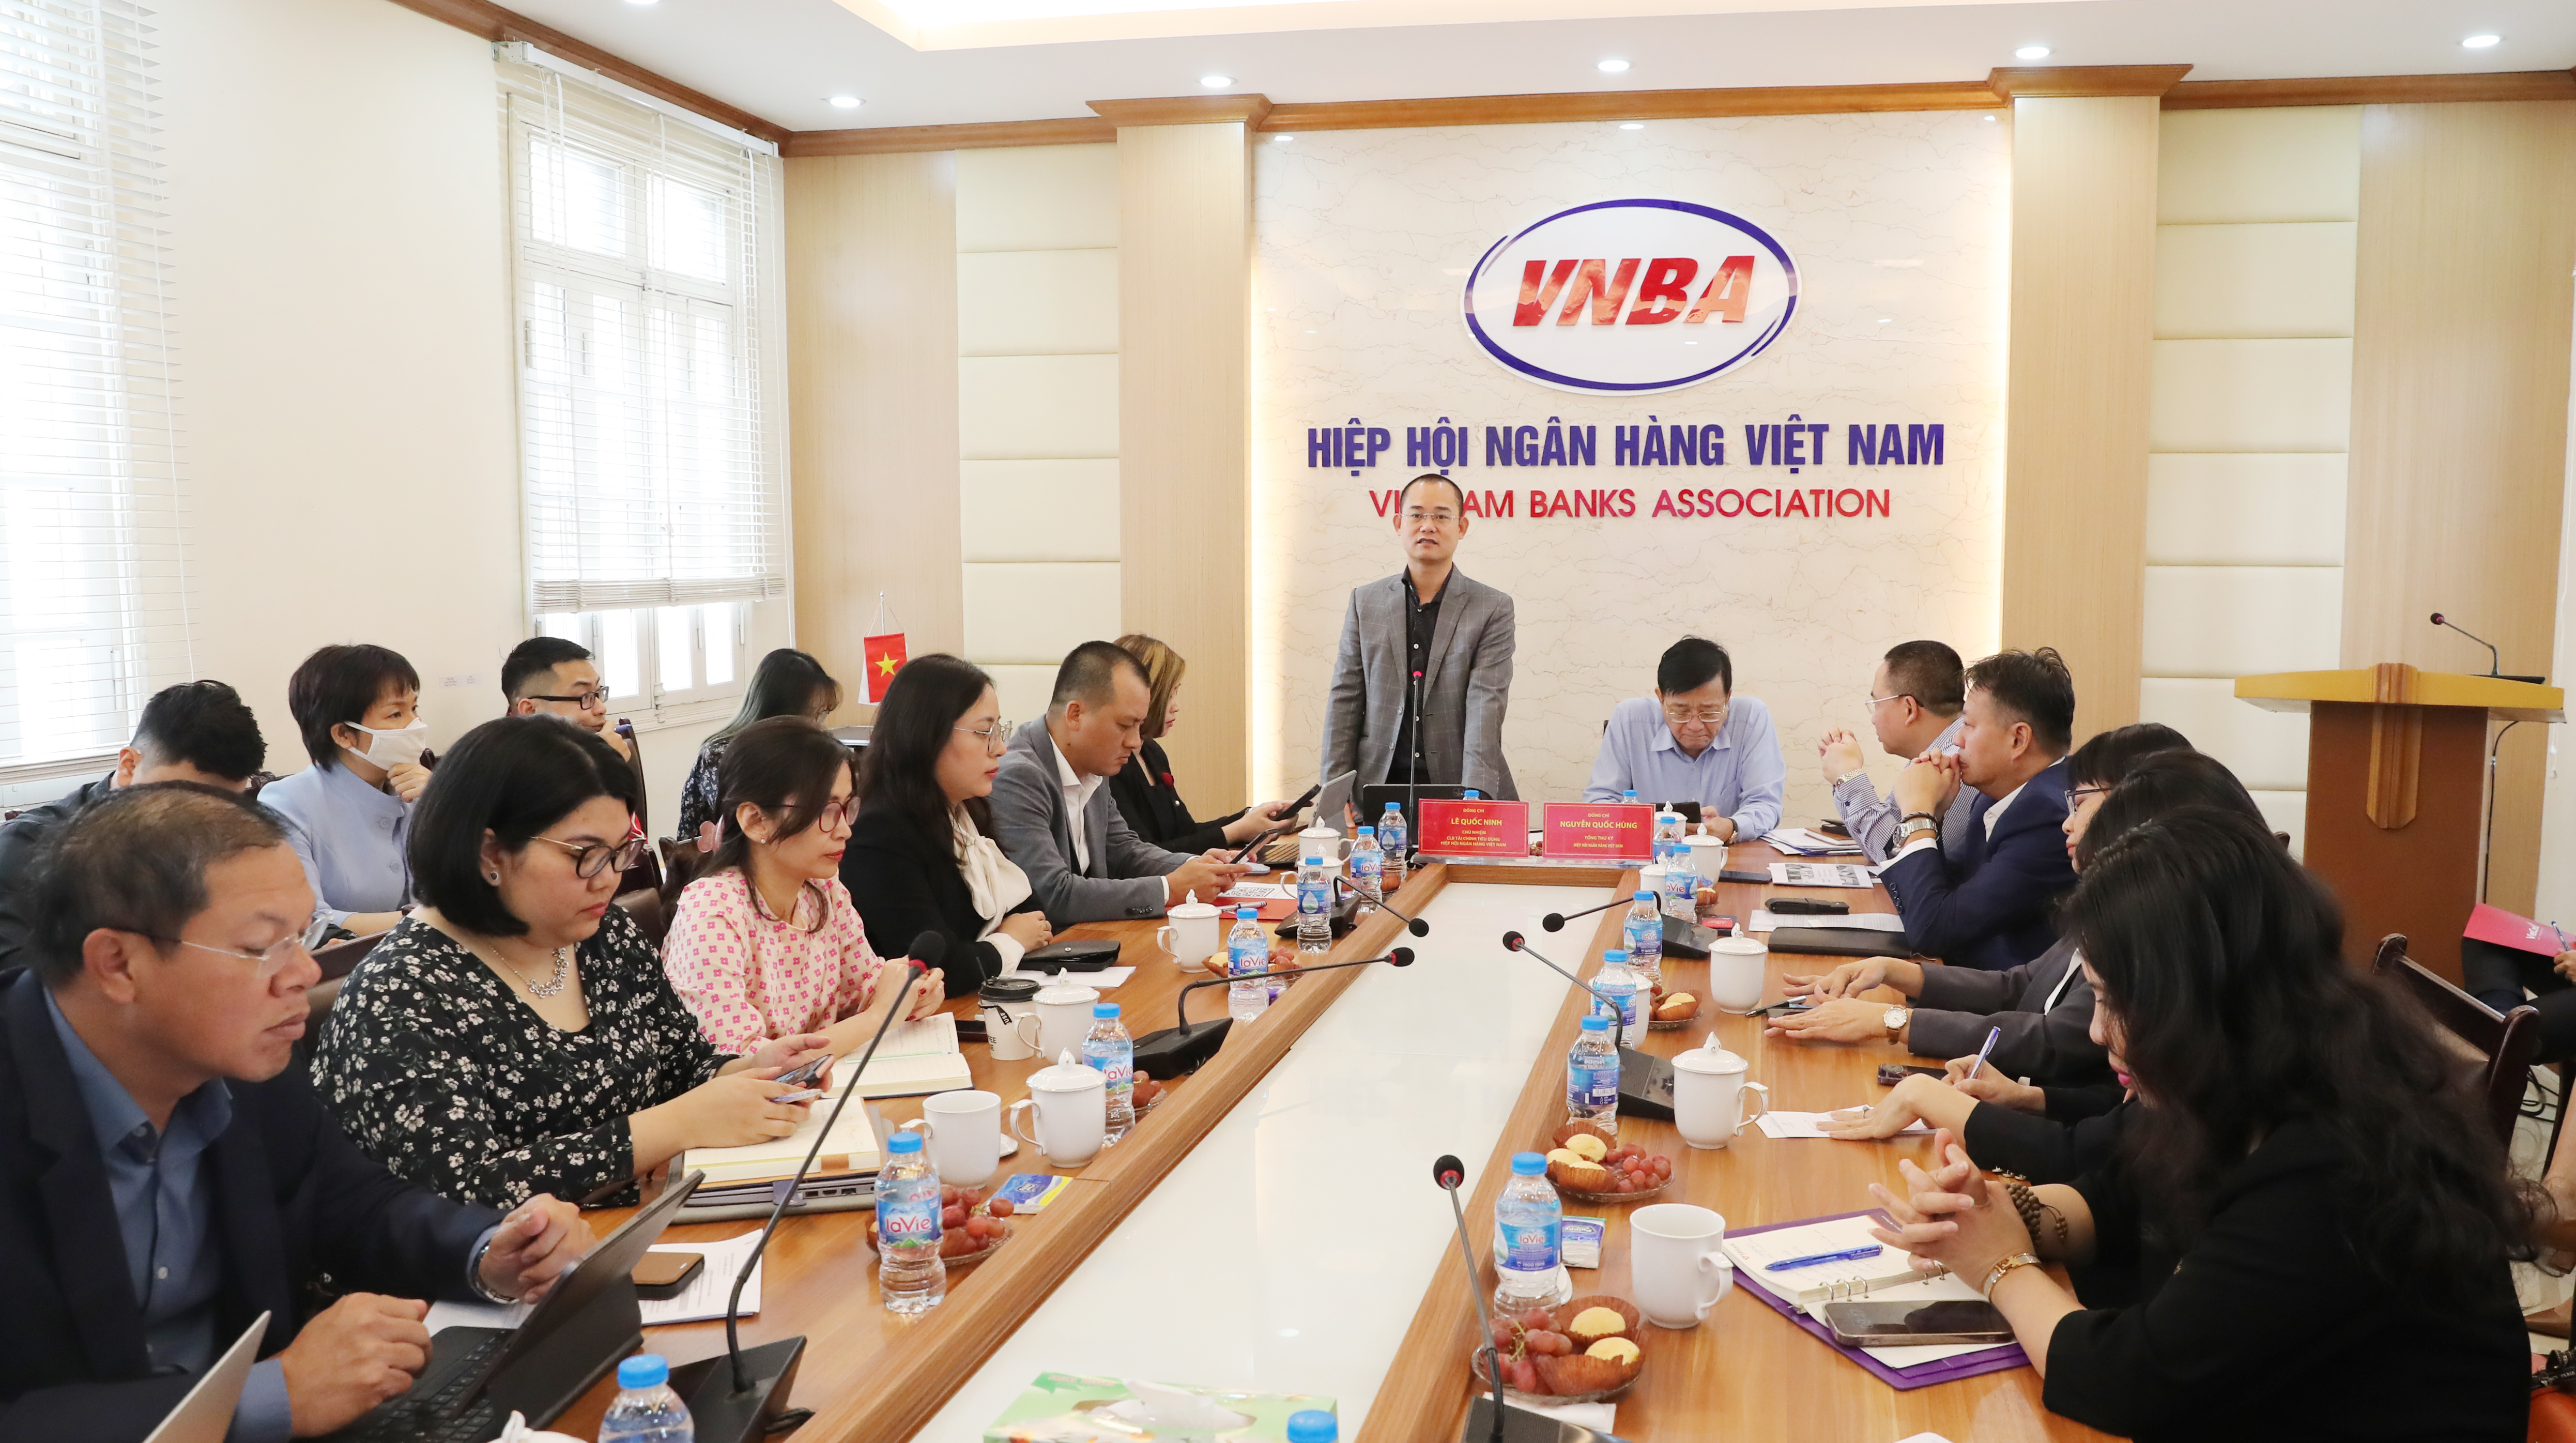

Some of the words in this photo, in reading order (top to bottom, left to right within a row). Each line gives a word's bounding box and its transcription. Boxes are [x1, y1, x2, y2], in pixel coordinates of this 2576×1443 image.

[1513, 255, 1755, 327] VNBA
[1308, 418, 1391, 477] HIỆP
[1407, 417, 1467, 475] HỘI
[1486, 416, 1596, 466] NGÂN
[1615, 415, 1724, 466] HÀNG
[1745, 414, 1829, 474] VIỆT
[1848, 424, 1944, 465] NAM
[1530, 488, 1636, 517] BANKS
[1651, 488, 1890, 517] ASSOCIATION
[1461, 817, 1482, 825] QUỐC
[1560, 819, 1591, 828] NGUYỄN
[1592, 820, 1614, 828] QUỐC
[1615, 820, 1637, 829] HÙNG
[1240, 956, 1266, 968] laVie
[886, 1216, 931, 1233] laVie
[1520, 1234, 1544, 1244] laVie
